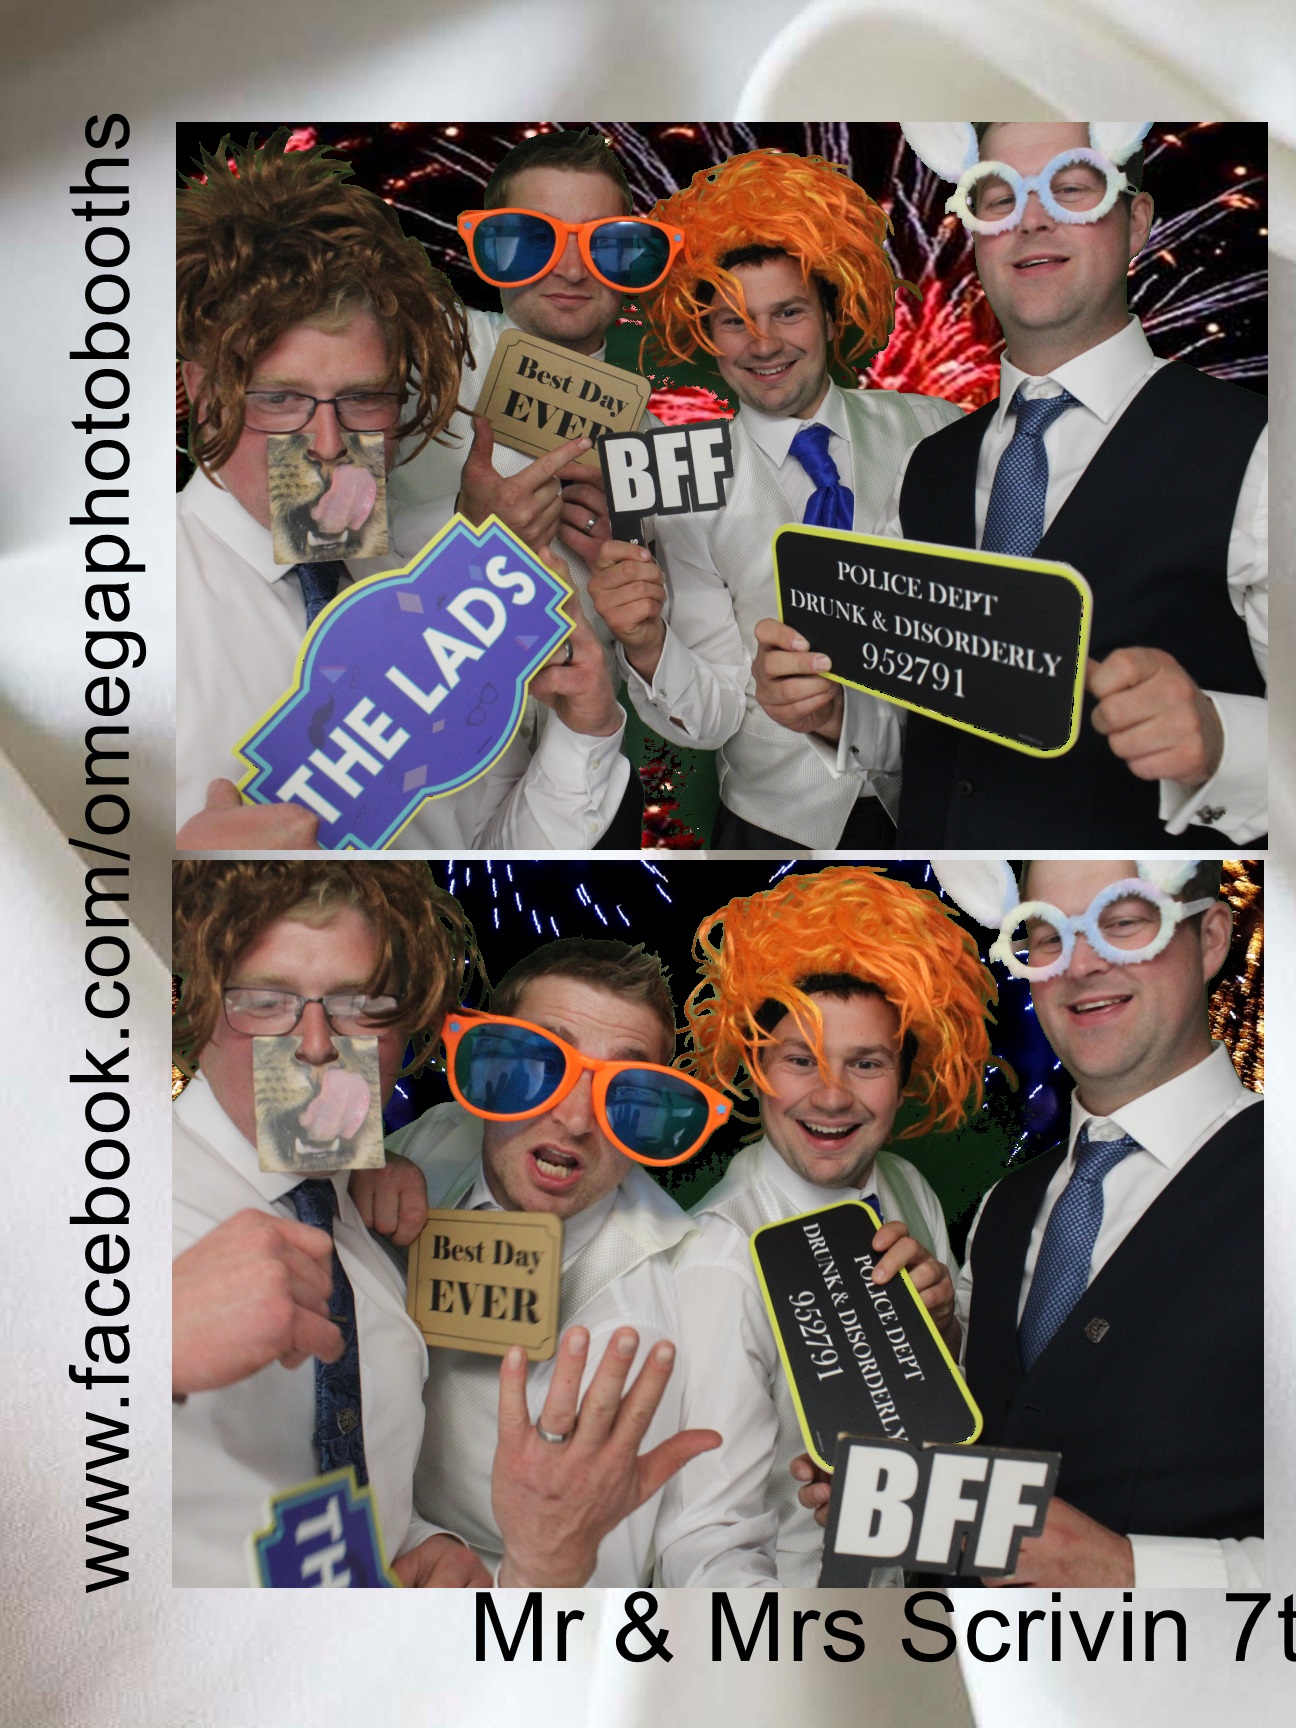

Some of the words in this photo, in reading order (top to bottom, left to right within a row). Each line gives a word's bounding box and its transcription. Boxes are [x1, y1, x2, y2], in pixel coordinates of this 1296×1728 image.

[515, 355, 573, 393] Best
[577, 378, 629, 418] Day
[604, 428, 725, 512] BFF
[837, 560, 923, 600] POLICE
[928, 581, 998, 616] DEPT
[790, 588, 868, 627] DRUNK
[872, 611, 888, 631] &
[895, 615, 1062, 678] DISORDERLY
[862, 642, 966, 699] 952791
[276, 695, 411, 825] THE
[385, 554, 537, 714] LADS
[432, 1234, 486, 1263] Best
[492, 1239, 544, 1275] Day
[802, 1222, 844, 1290] DRUNK
[428, 1278, 541, 1324] EVER
[788, 1290, 845, 1382] 952791
[830, 1291, 849, 1308] &
[854, 1253, 899, 1326] POLICE
[885, 1326, 925, 1382] DEPT
[838, 1308, 910, 1442] DISORDERLY
[834, 1445, 1049, 1569] BFF
